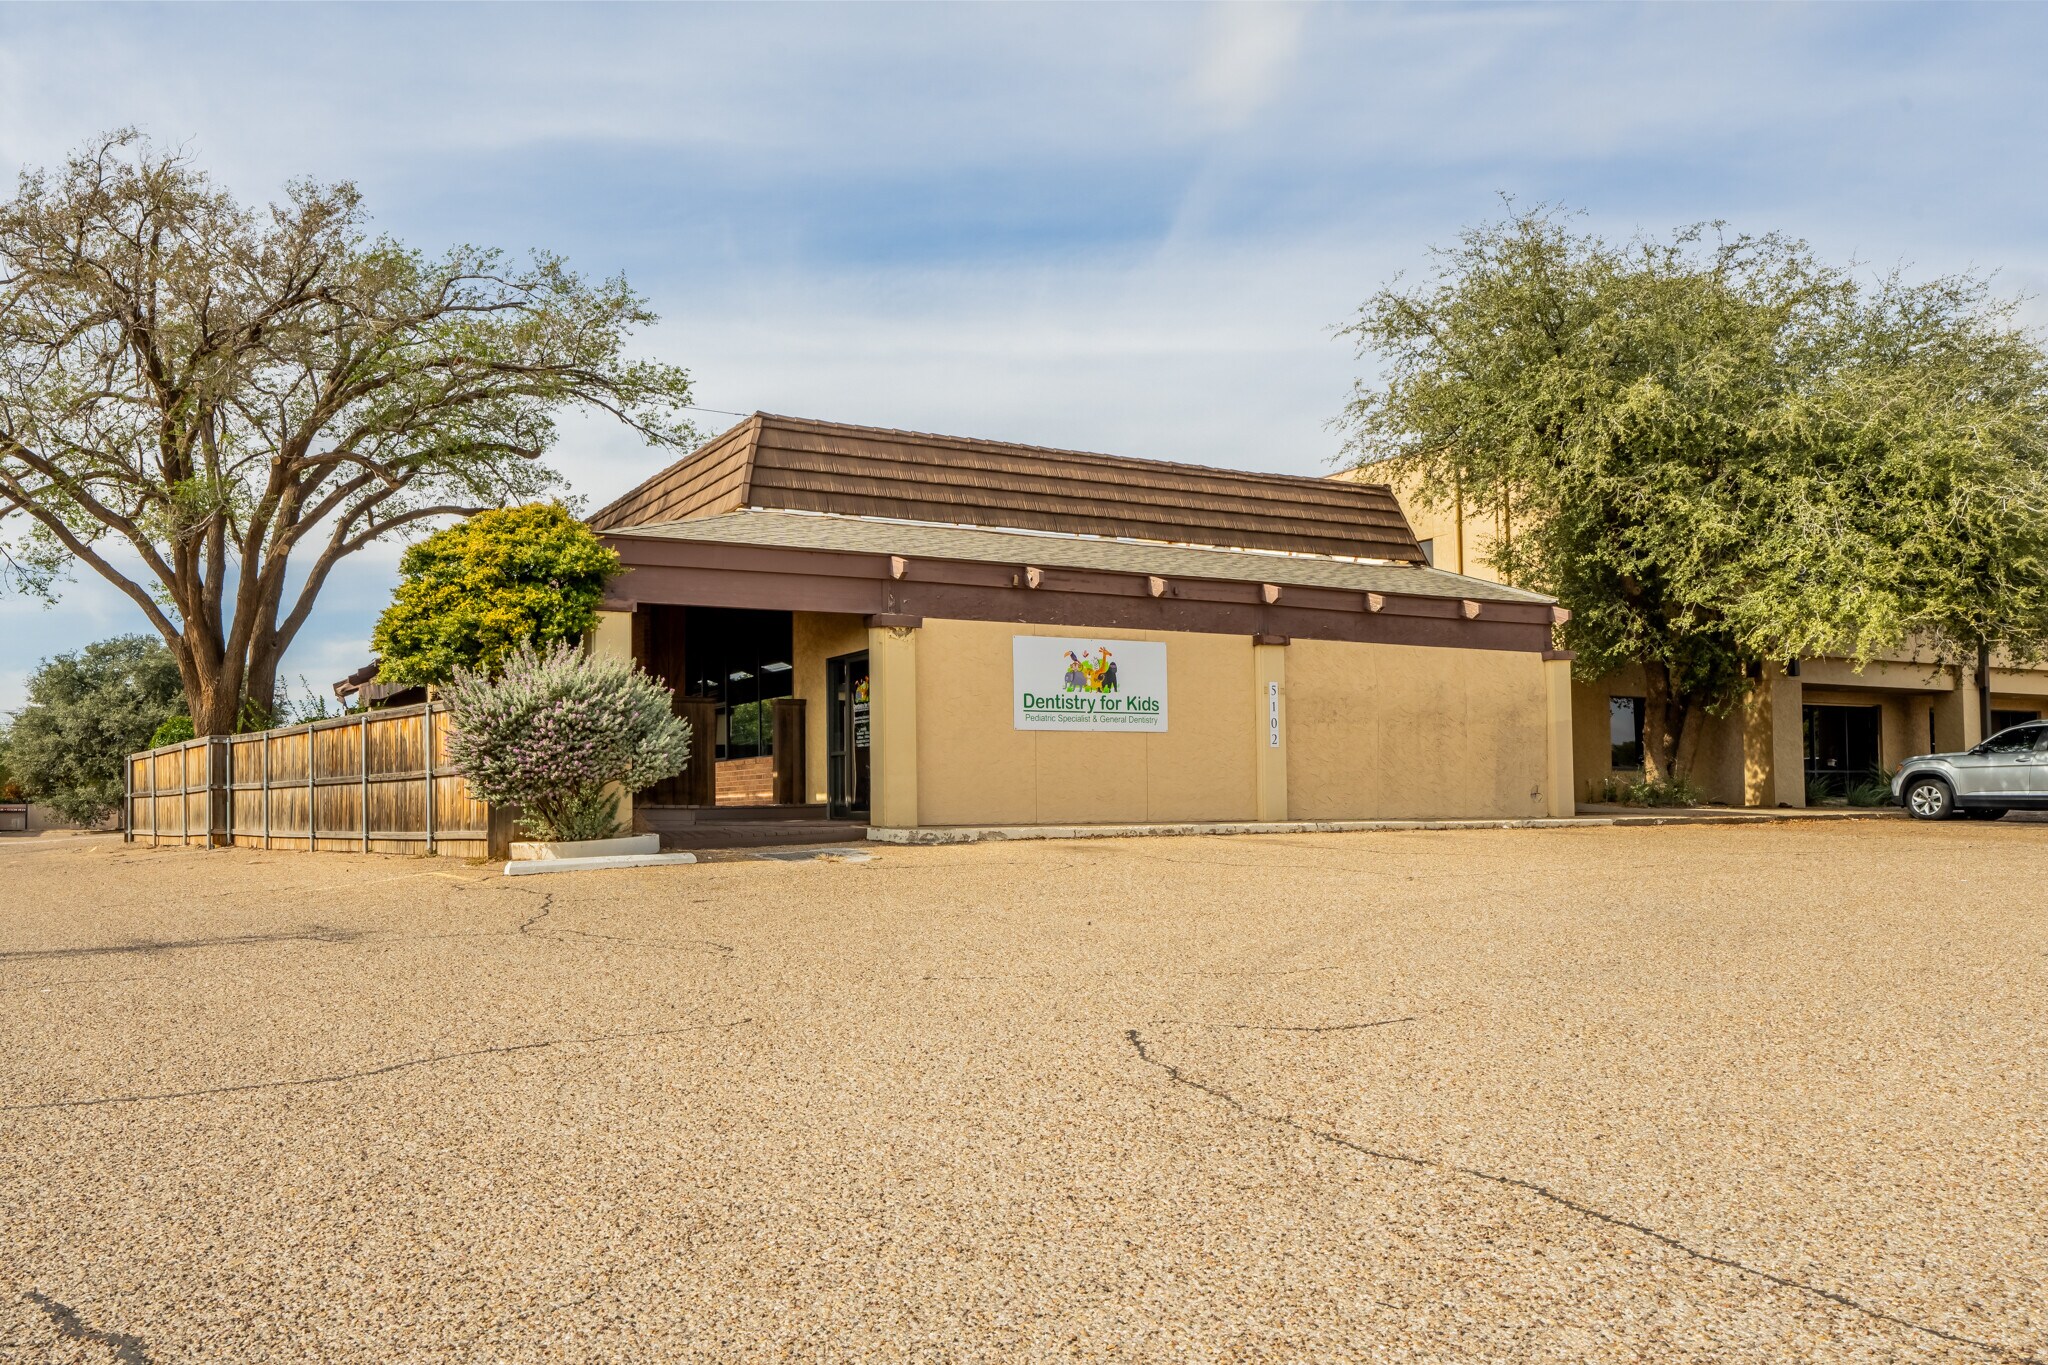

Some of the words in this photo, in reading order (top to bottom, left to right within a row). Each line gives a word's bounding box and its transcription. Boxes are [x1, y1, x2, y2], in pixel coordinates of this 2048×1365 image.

[1023, 693, 1096, 713] Dentistry
[1100, 695, 1122, 710] for
[1126, 696, 1160, 711] Kids
[1025, 714, 1056, 722] Pediatric
[1057, 715, 1091, 723] Specialist
[1099, 715, 1127, 723] General
[1128, 716, 1158, 725] Dentistry
[1270, 685, 1278, 745] 5102
